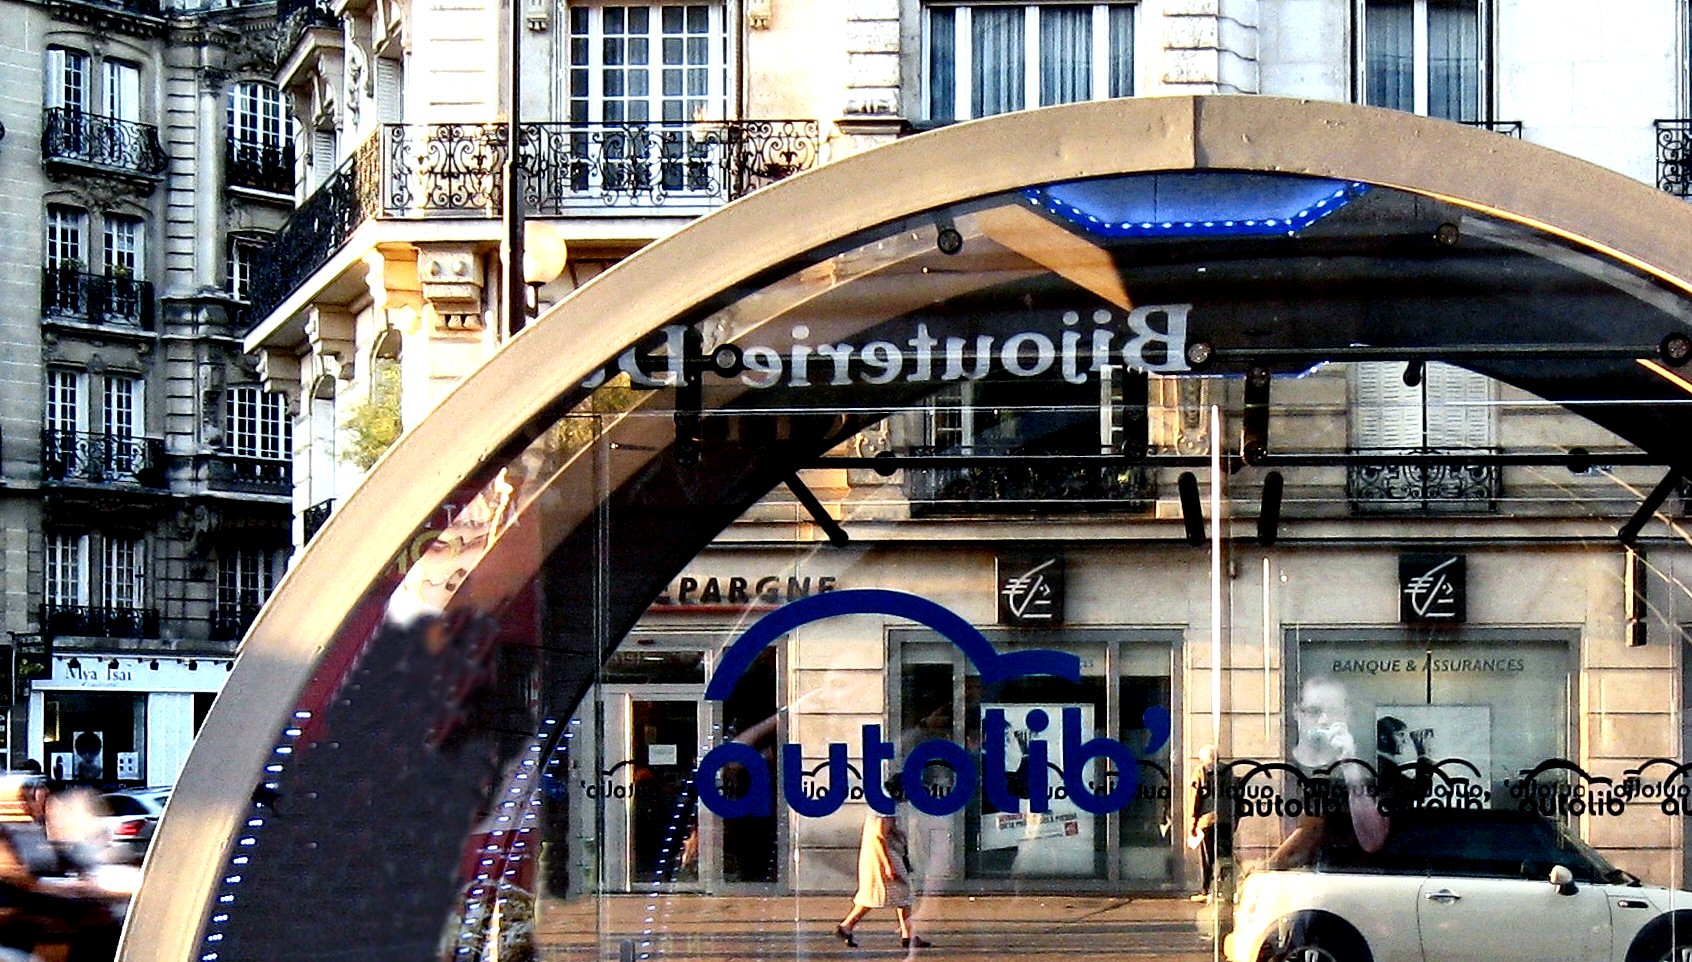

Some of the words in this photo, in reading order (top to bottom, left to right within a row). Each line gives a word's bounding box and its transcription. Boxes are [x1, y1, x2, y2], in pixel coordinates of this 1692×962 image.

[1332, 659, 1401, 675] BANQUE
[1405, 659, 1417, 673] &
[699, 704, 1171, 818] autolib'
